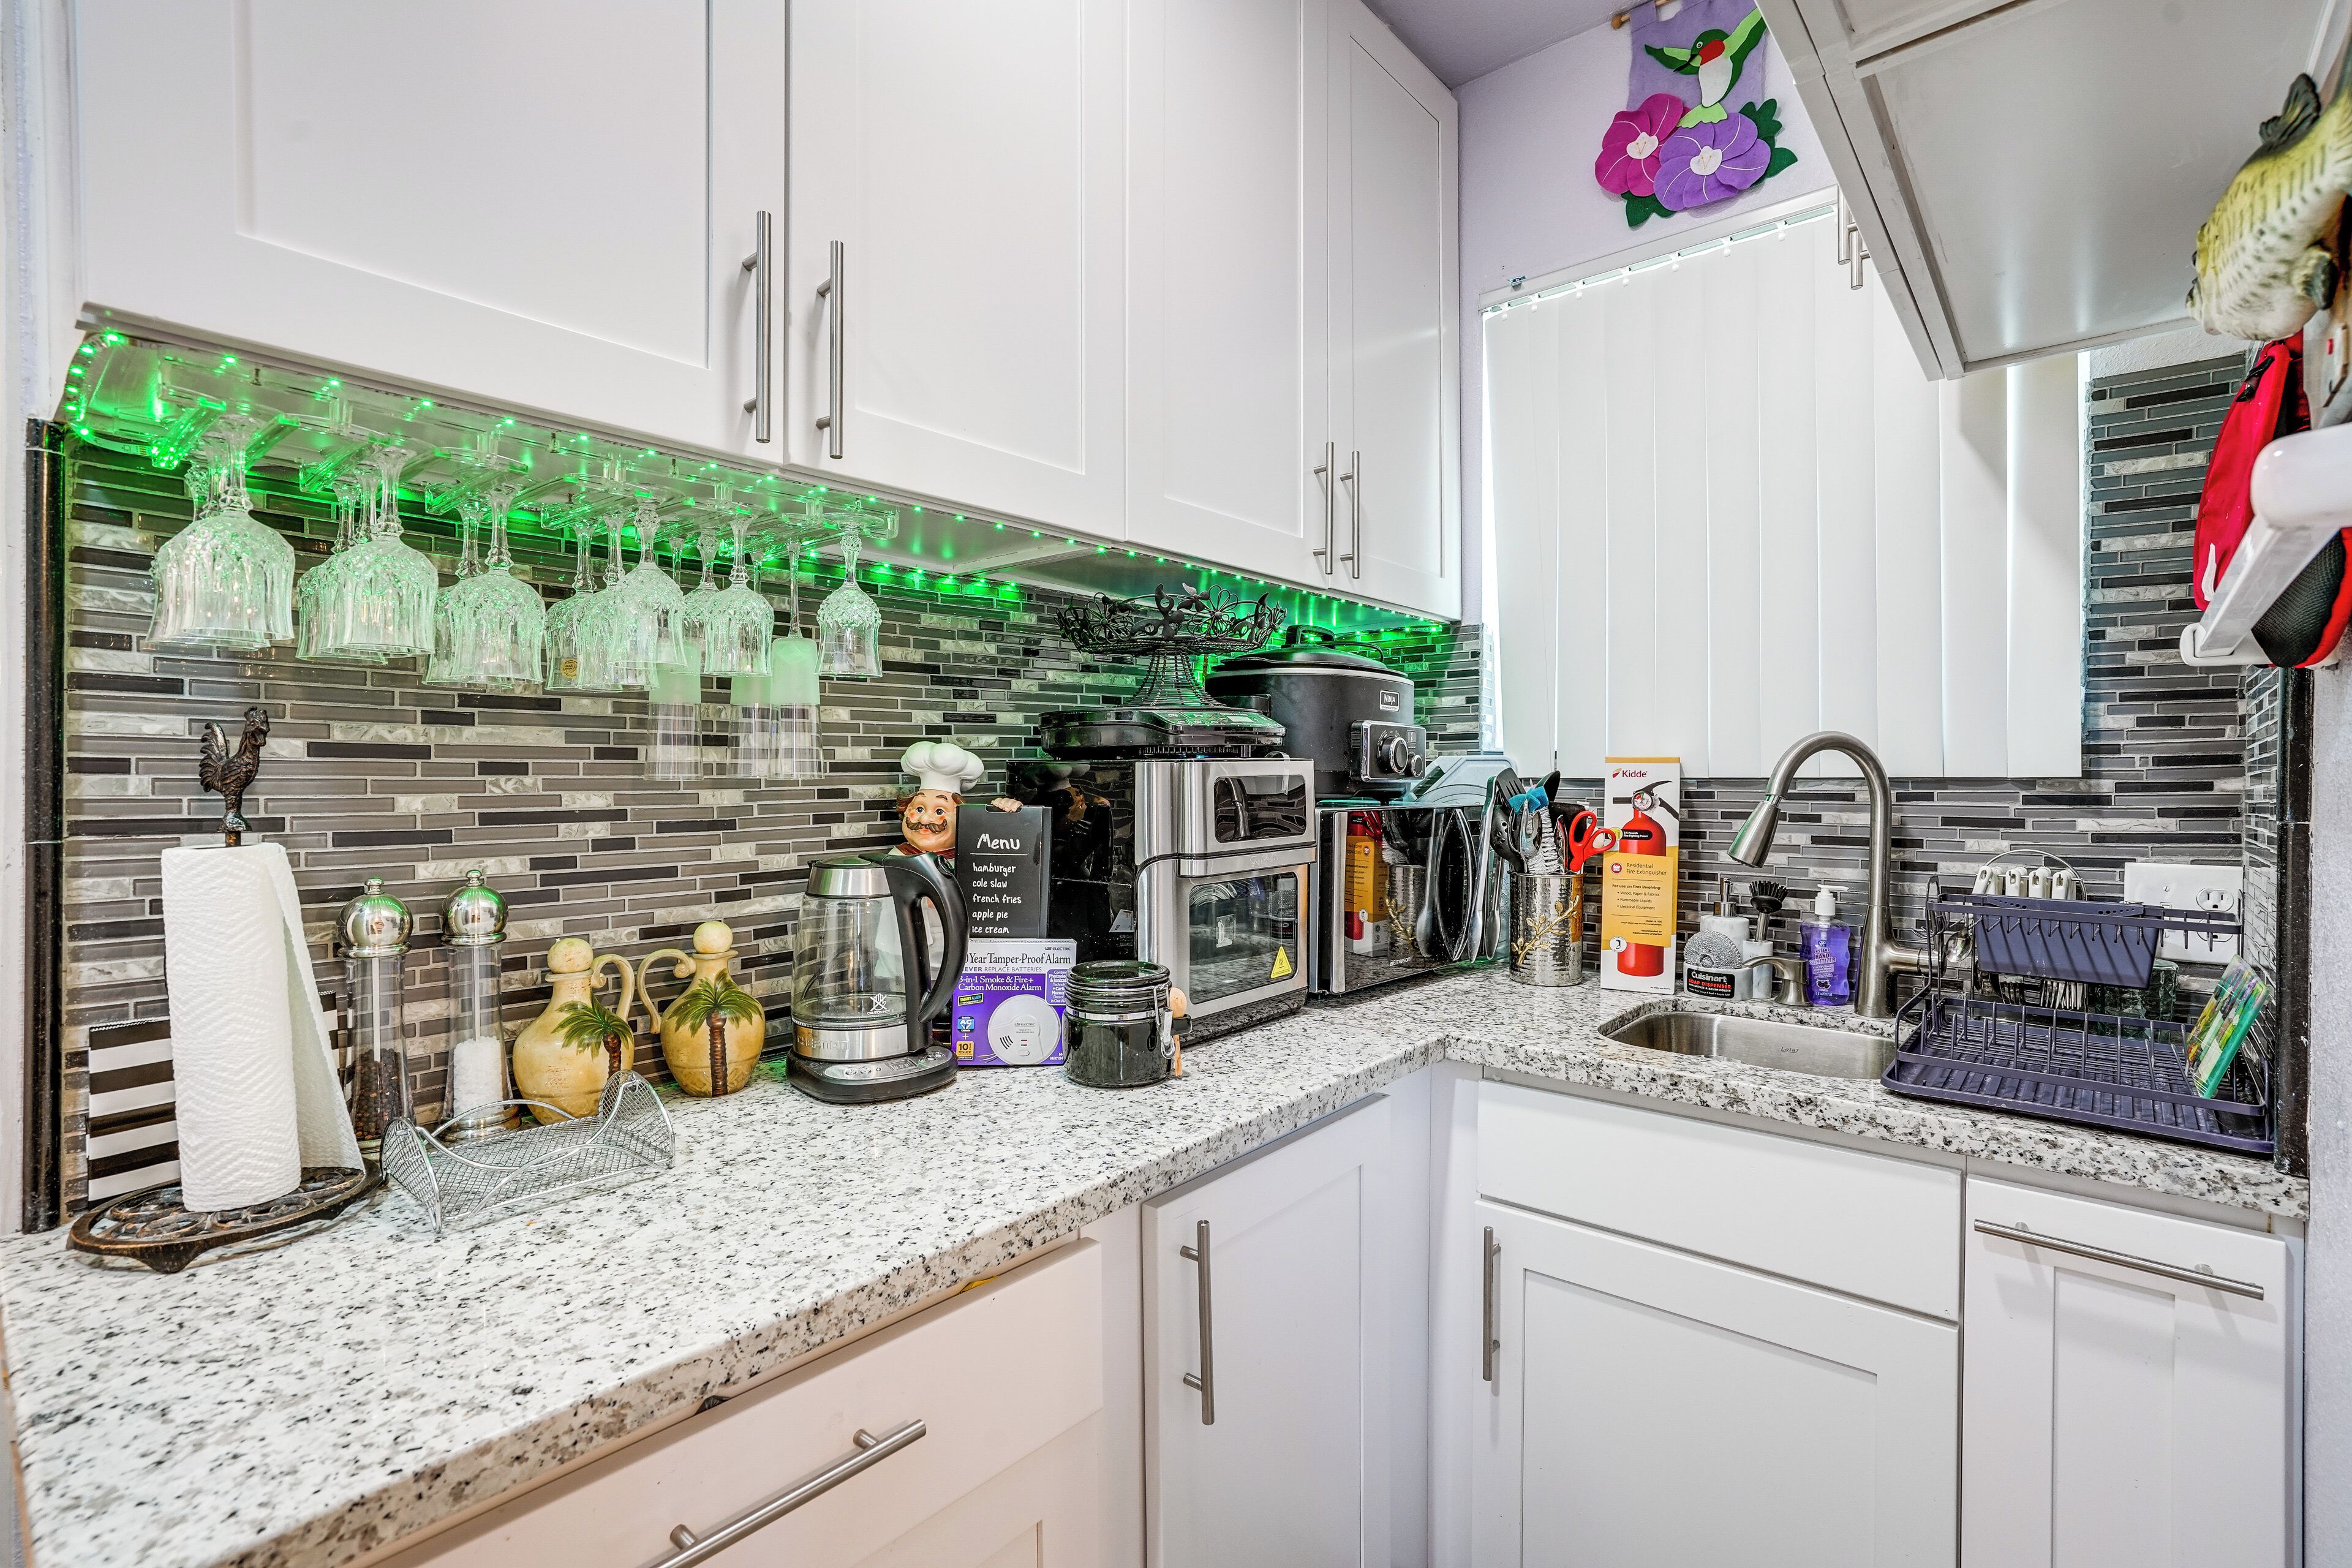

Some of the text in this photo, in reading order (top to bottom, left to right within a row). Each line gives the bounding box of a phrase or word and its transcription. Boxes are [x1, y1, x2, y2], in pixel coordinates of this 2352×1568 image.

[1384, 693, 1396, 705] NINJA
[976, 833, 1020, 850] Menu
[973, 862, 1016, 876] hamburger
[972, 878, 1008, 888] cole slaw
[972, 893, 1022, 904] french fries
[972, 909, 1008, 921] apple pie
[969, 952, 987, 963] Year
[987, 952, 1045, 966] Tamper-Proof
[1046, 953, 1071, 964] Alarm
[1691, 971, 1727, 982] Cuisinart
